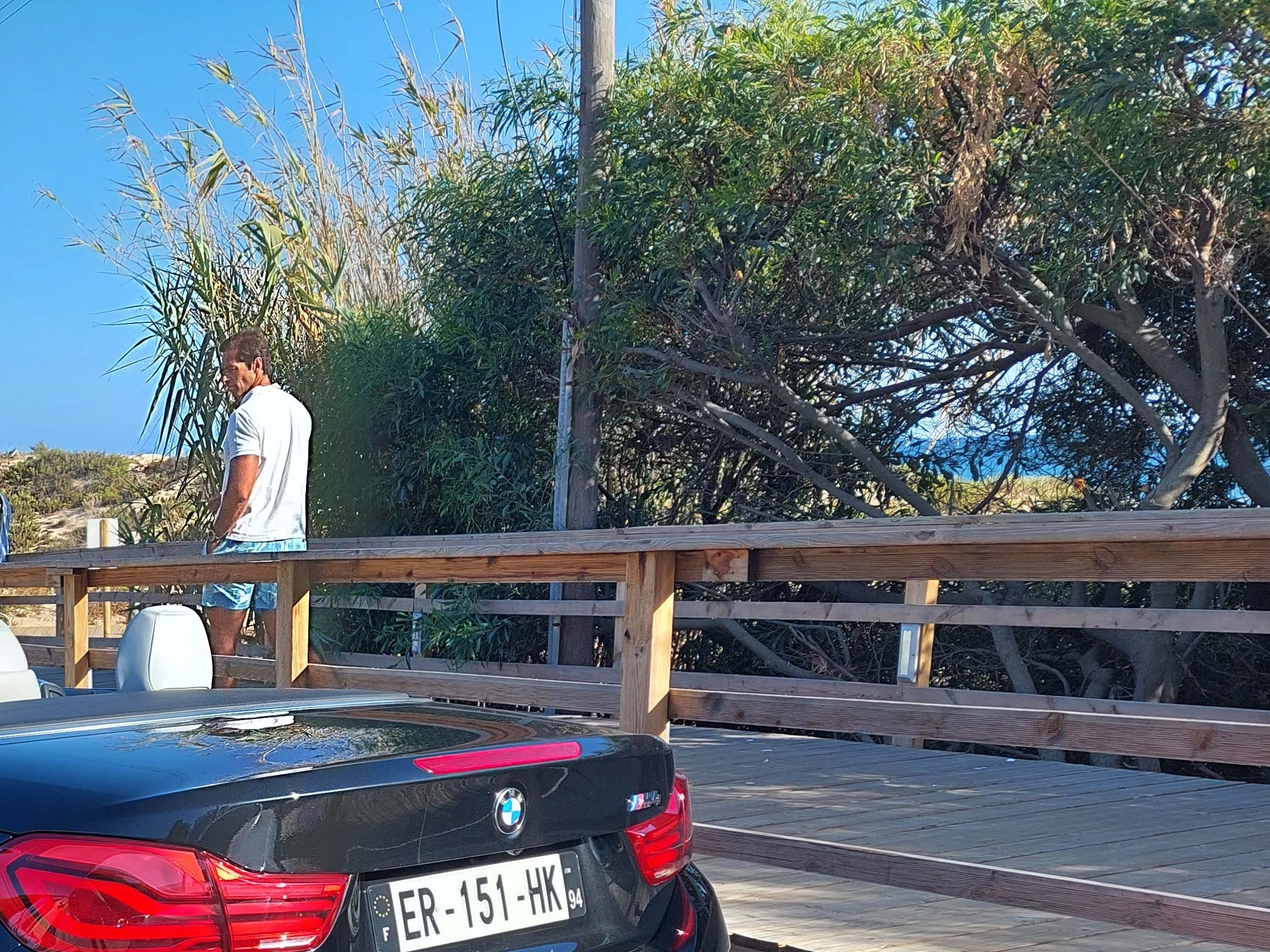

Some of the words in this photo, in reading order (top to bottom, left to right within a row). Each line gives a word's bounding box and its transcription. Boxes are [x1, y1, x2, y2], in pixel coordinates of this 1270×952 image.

[398, 864, 562, 941] ER-151-HK
[568, 888, 583, 910] 94
[382, 926, 390, 942] F
